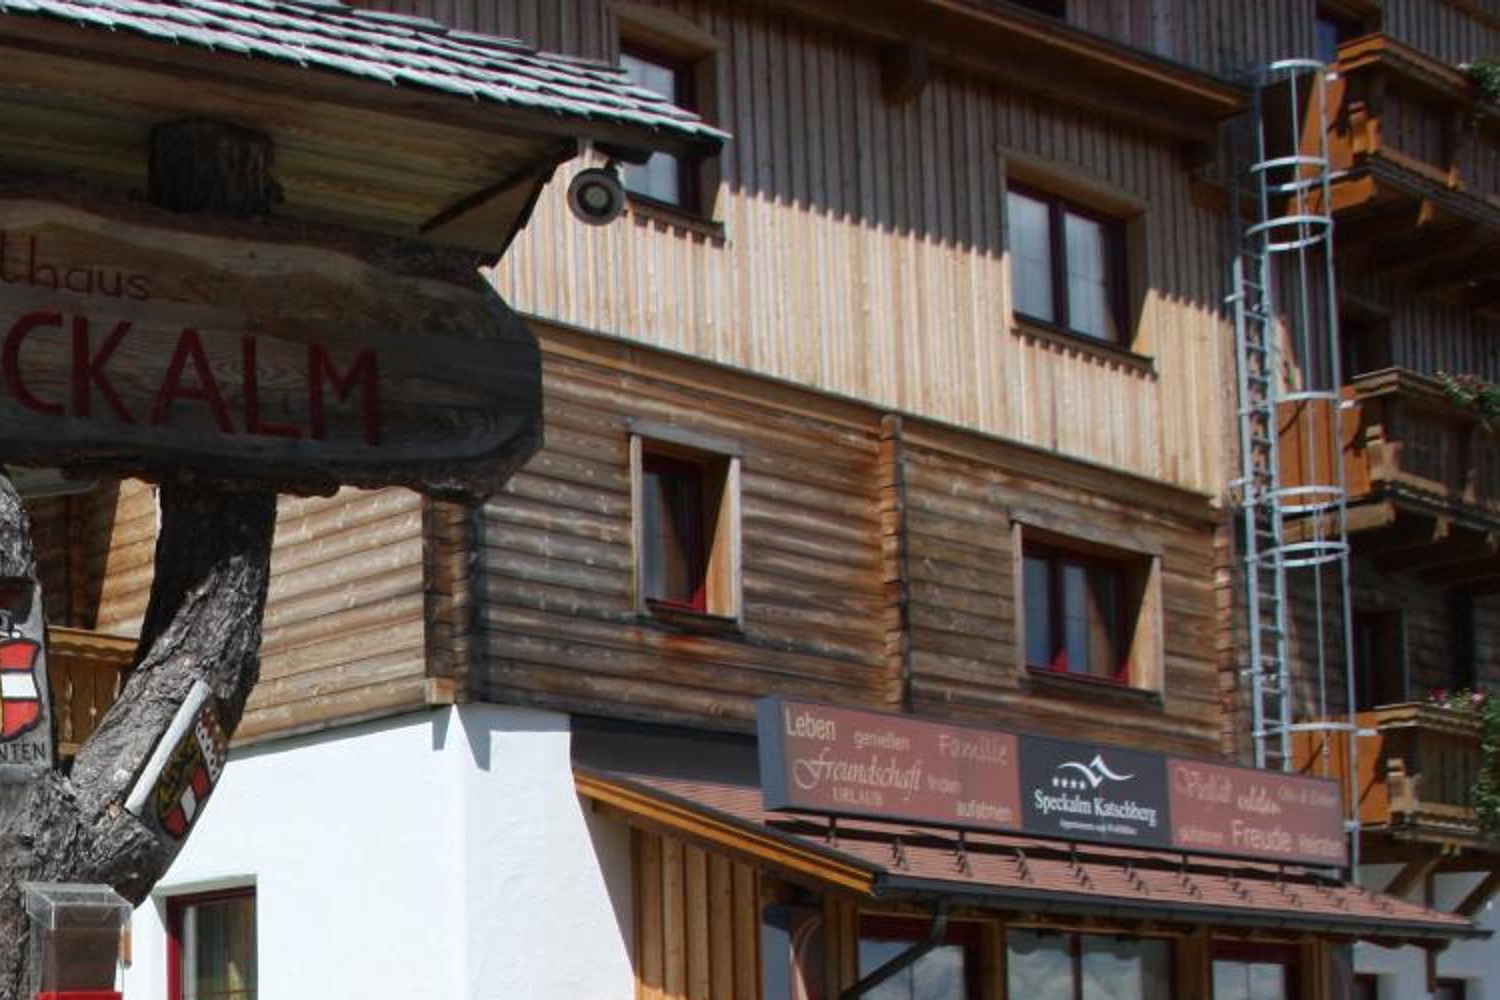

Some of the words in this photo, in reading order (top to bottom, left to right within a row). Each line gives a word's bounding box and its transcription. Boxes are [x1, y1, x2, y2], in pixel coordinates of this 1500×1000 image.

[785, 706, 837, 741] Leben
[1034, 789, 1093, 815] Speckalm
[1094, 797, 1157, 827] Katschberg
[1231, 818, 1293, 853] Freude
